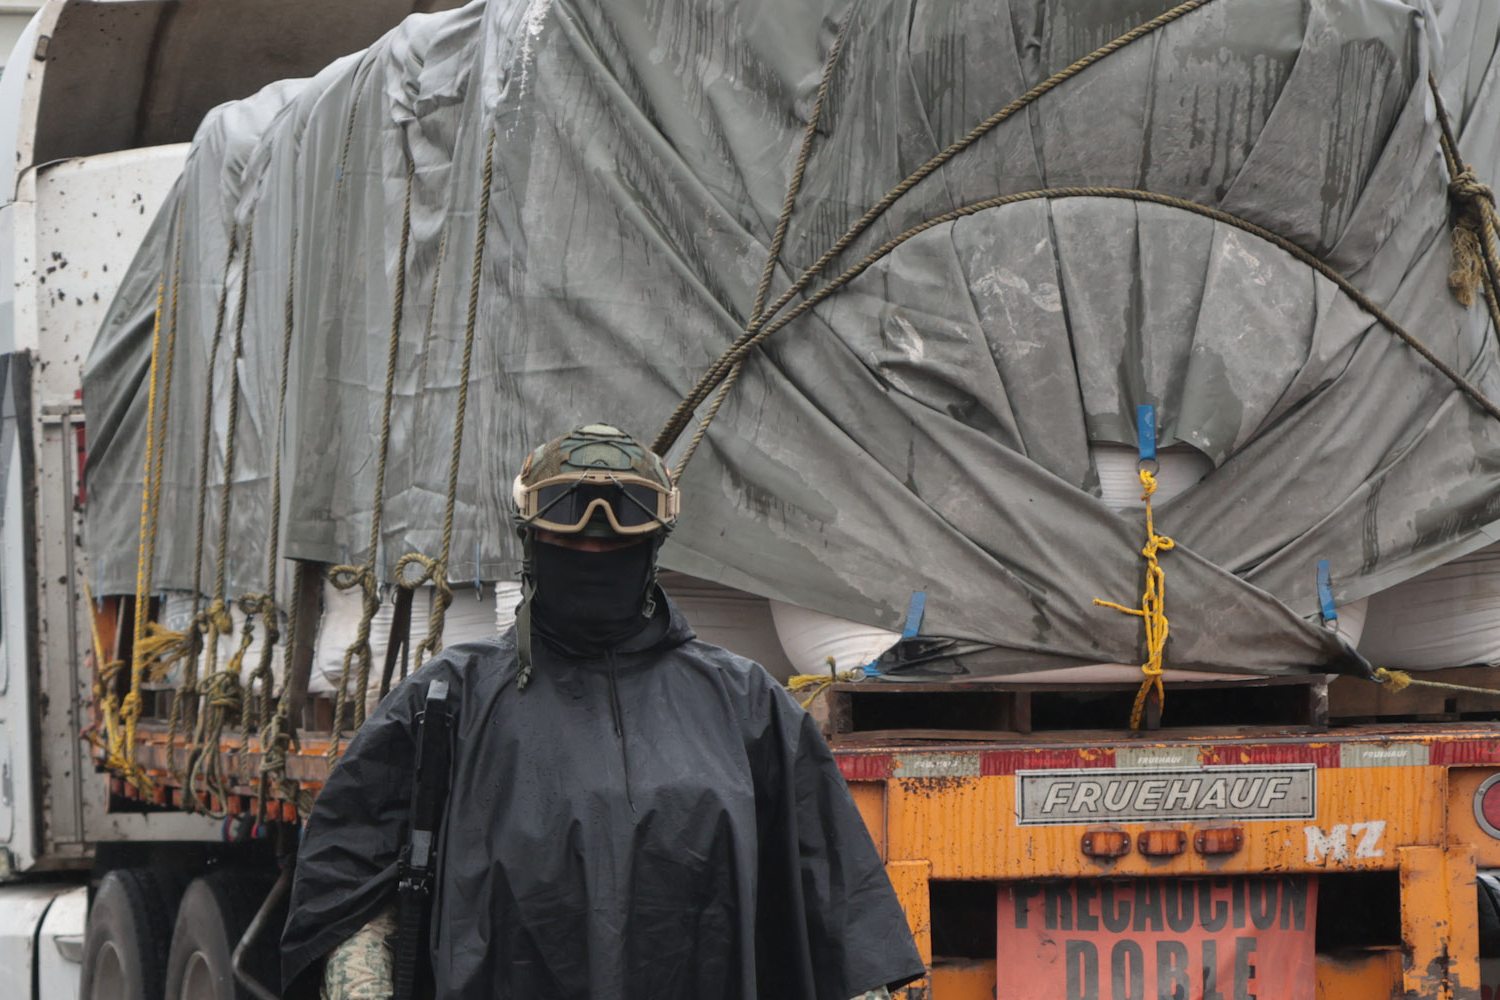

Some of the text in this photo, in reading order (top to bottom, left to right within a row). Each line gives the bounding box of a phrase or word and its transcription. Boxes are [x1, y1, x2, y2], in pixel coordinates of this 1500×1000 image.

[1137, 756, 1183, 765] FRUEHAUF
[1362, 751, 1409, 760] FRUEHAUF
[1041, 776, 1292, 814] FRUEHAUF
[1302, 820, 1387, 863] MZ
